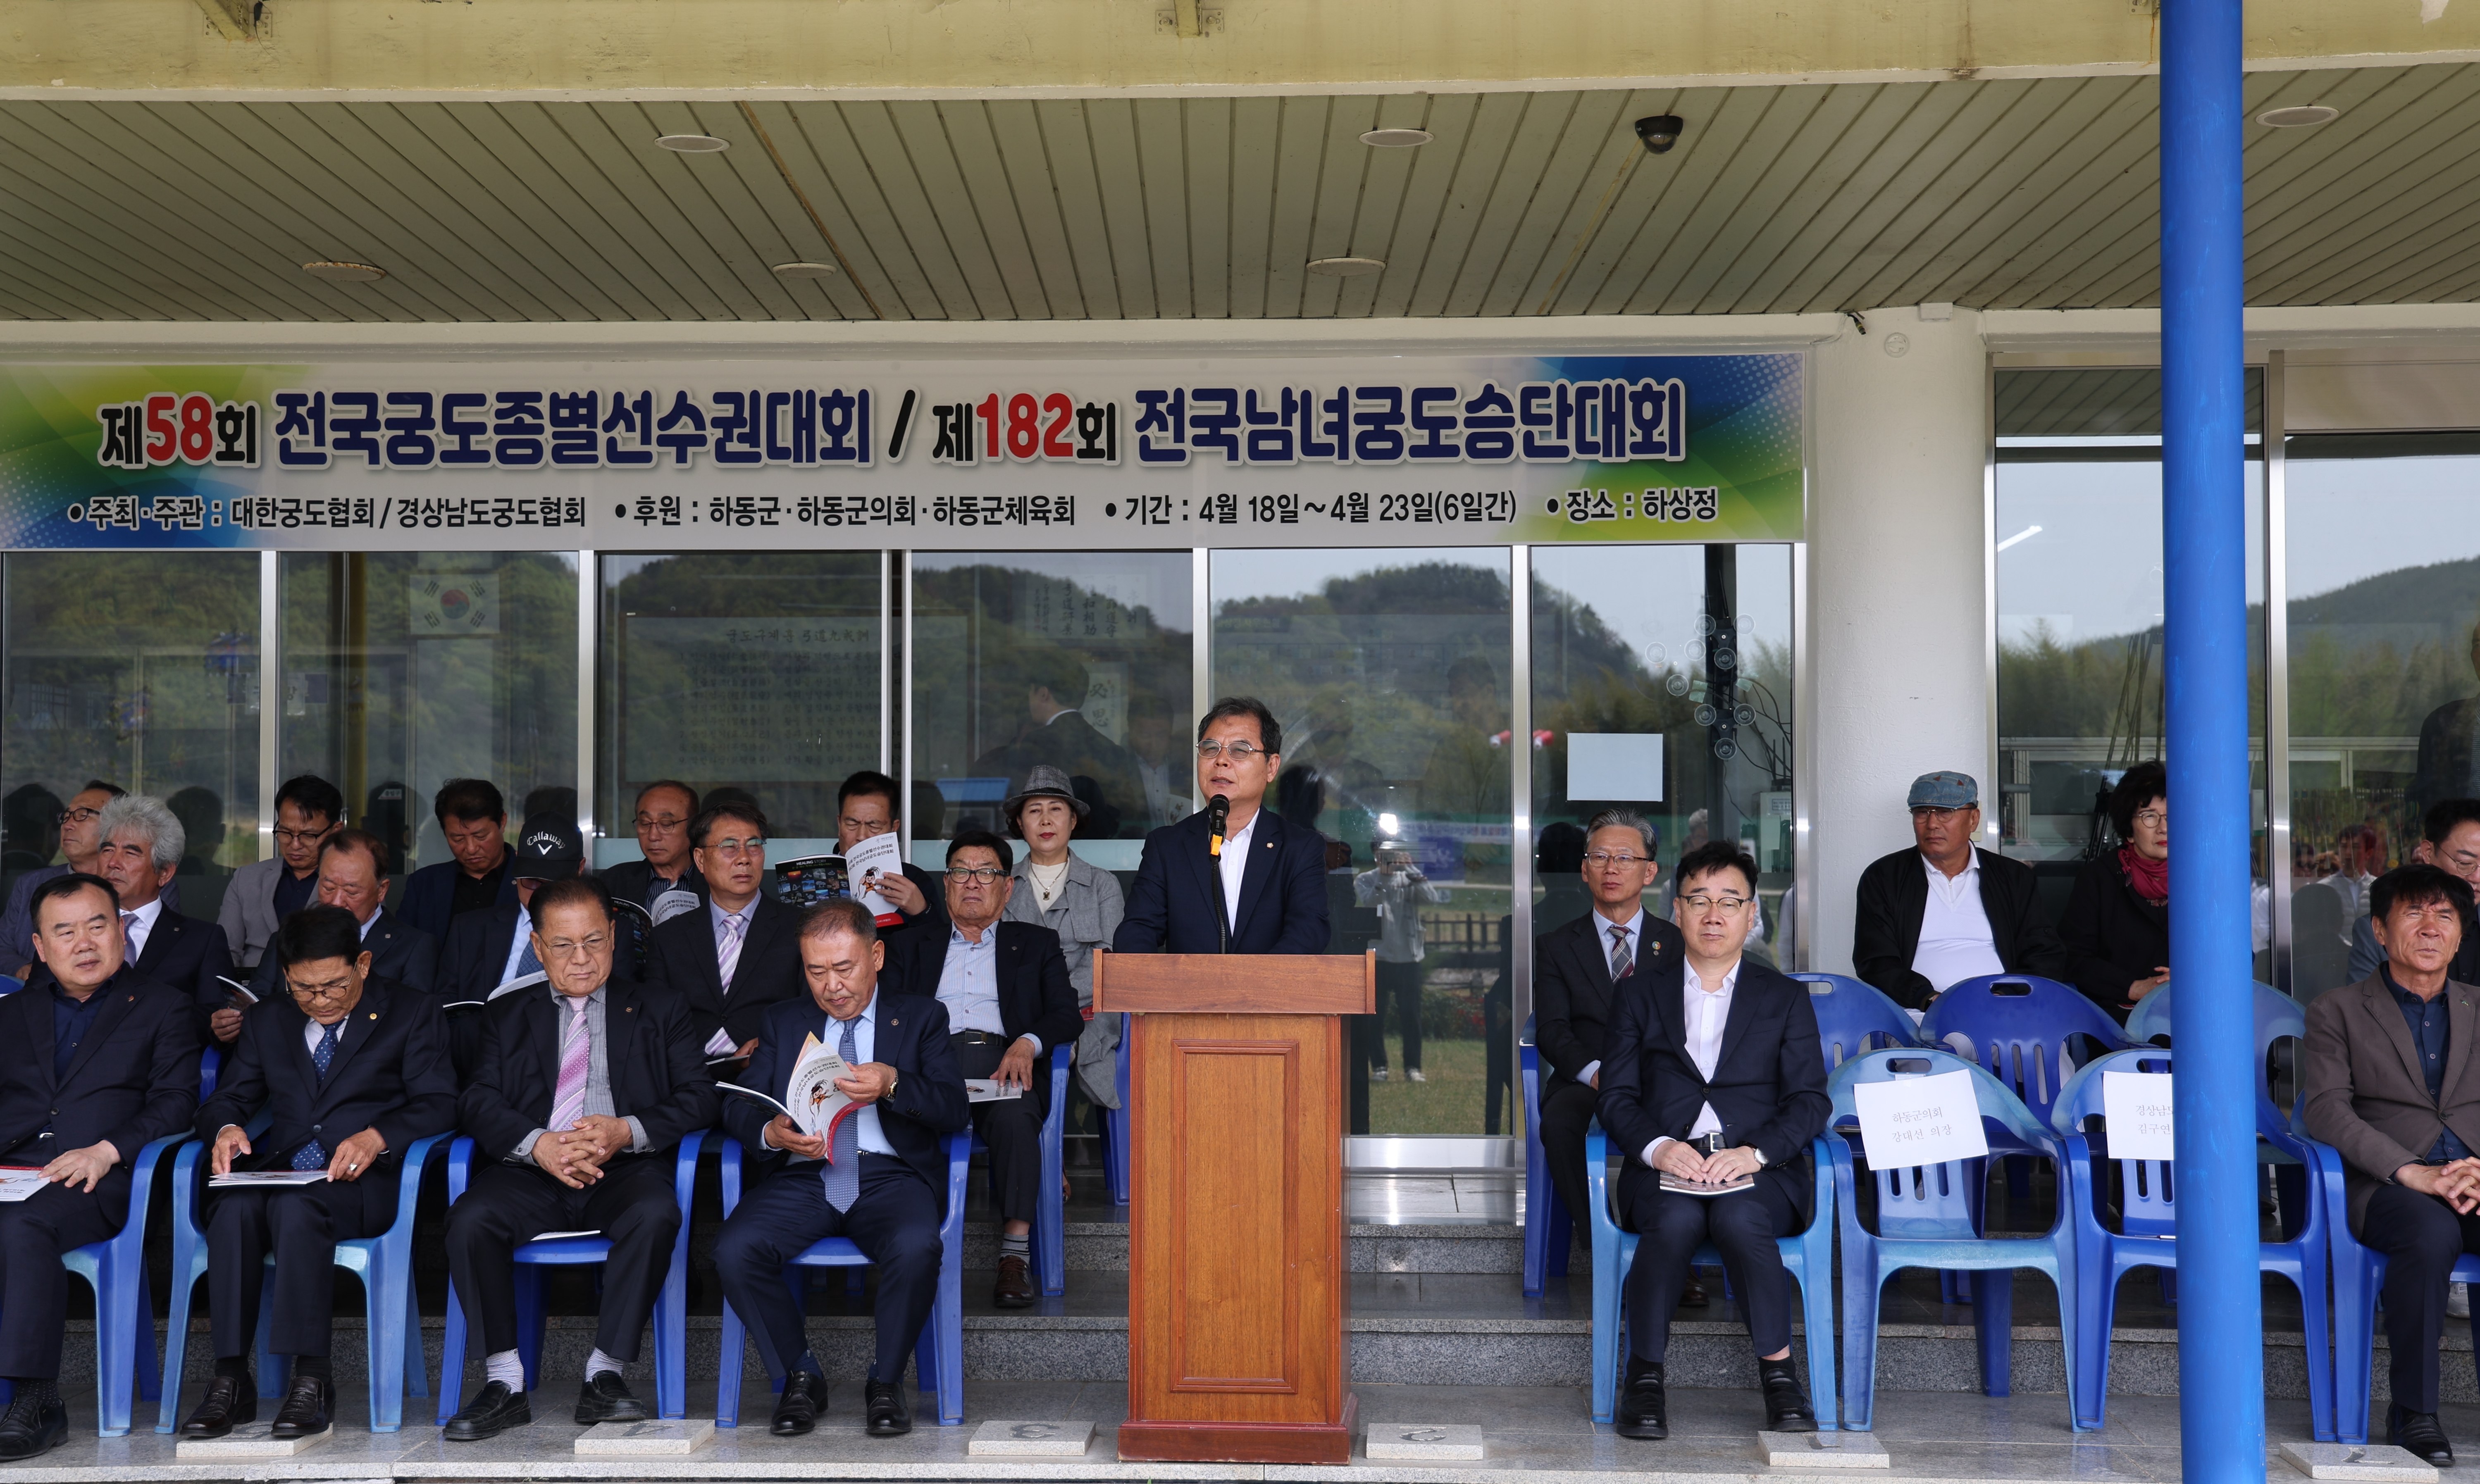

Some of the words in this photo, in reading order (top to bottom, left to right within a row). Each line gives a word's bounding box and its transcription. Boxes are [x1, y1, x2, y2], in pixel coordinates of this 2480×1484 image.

[101, 395, 257, 464] 제58회
[274, 390, 870, 466] 전국궁도종별선수권대회
[888, 389, 916, 459] /
[932, 392, 1117, 462] 제182회
[1135, 383, 1681, 462] 전국남녀궁도승단대회
[88, 498, 203, 527] 주최·주관
[633, 496, 681, 526] 후원
[1125, 495, 1172, 525] 기간
[1199, 494, 1238, 525] 4월
[1380, 491, 1517, 525] 23일(6일간)
[1565, 490, 1615, 522] 장소
[1642, 487, 1717, 523] 하상정
[527, 831, 565, 849] Callaway
[1892, 1106, 1943, 1124] 하동군의회
[1891, 1128, 1924, 1143] 강대선
[1930, 1124, 1952, 1137] 의장
[2138, 1123, 2171, 1135] 김구연
